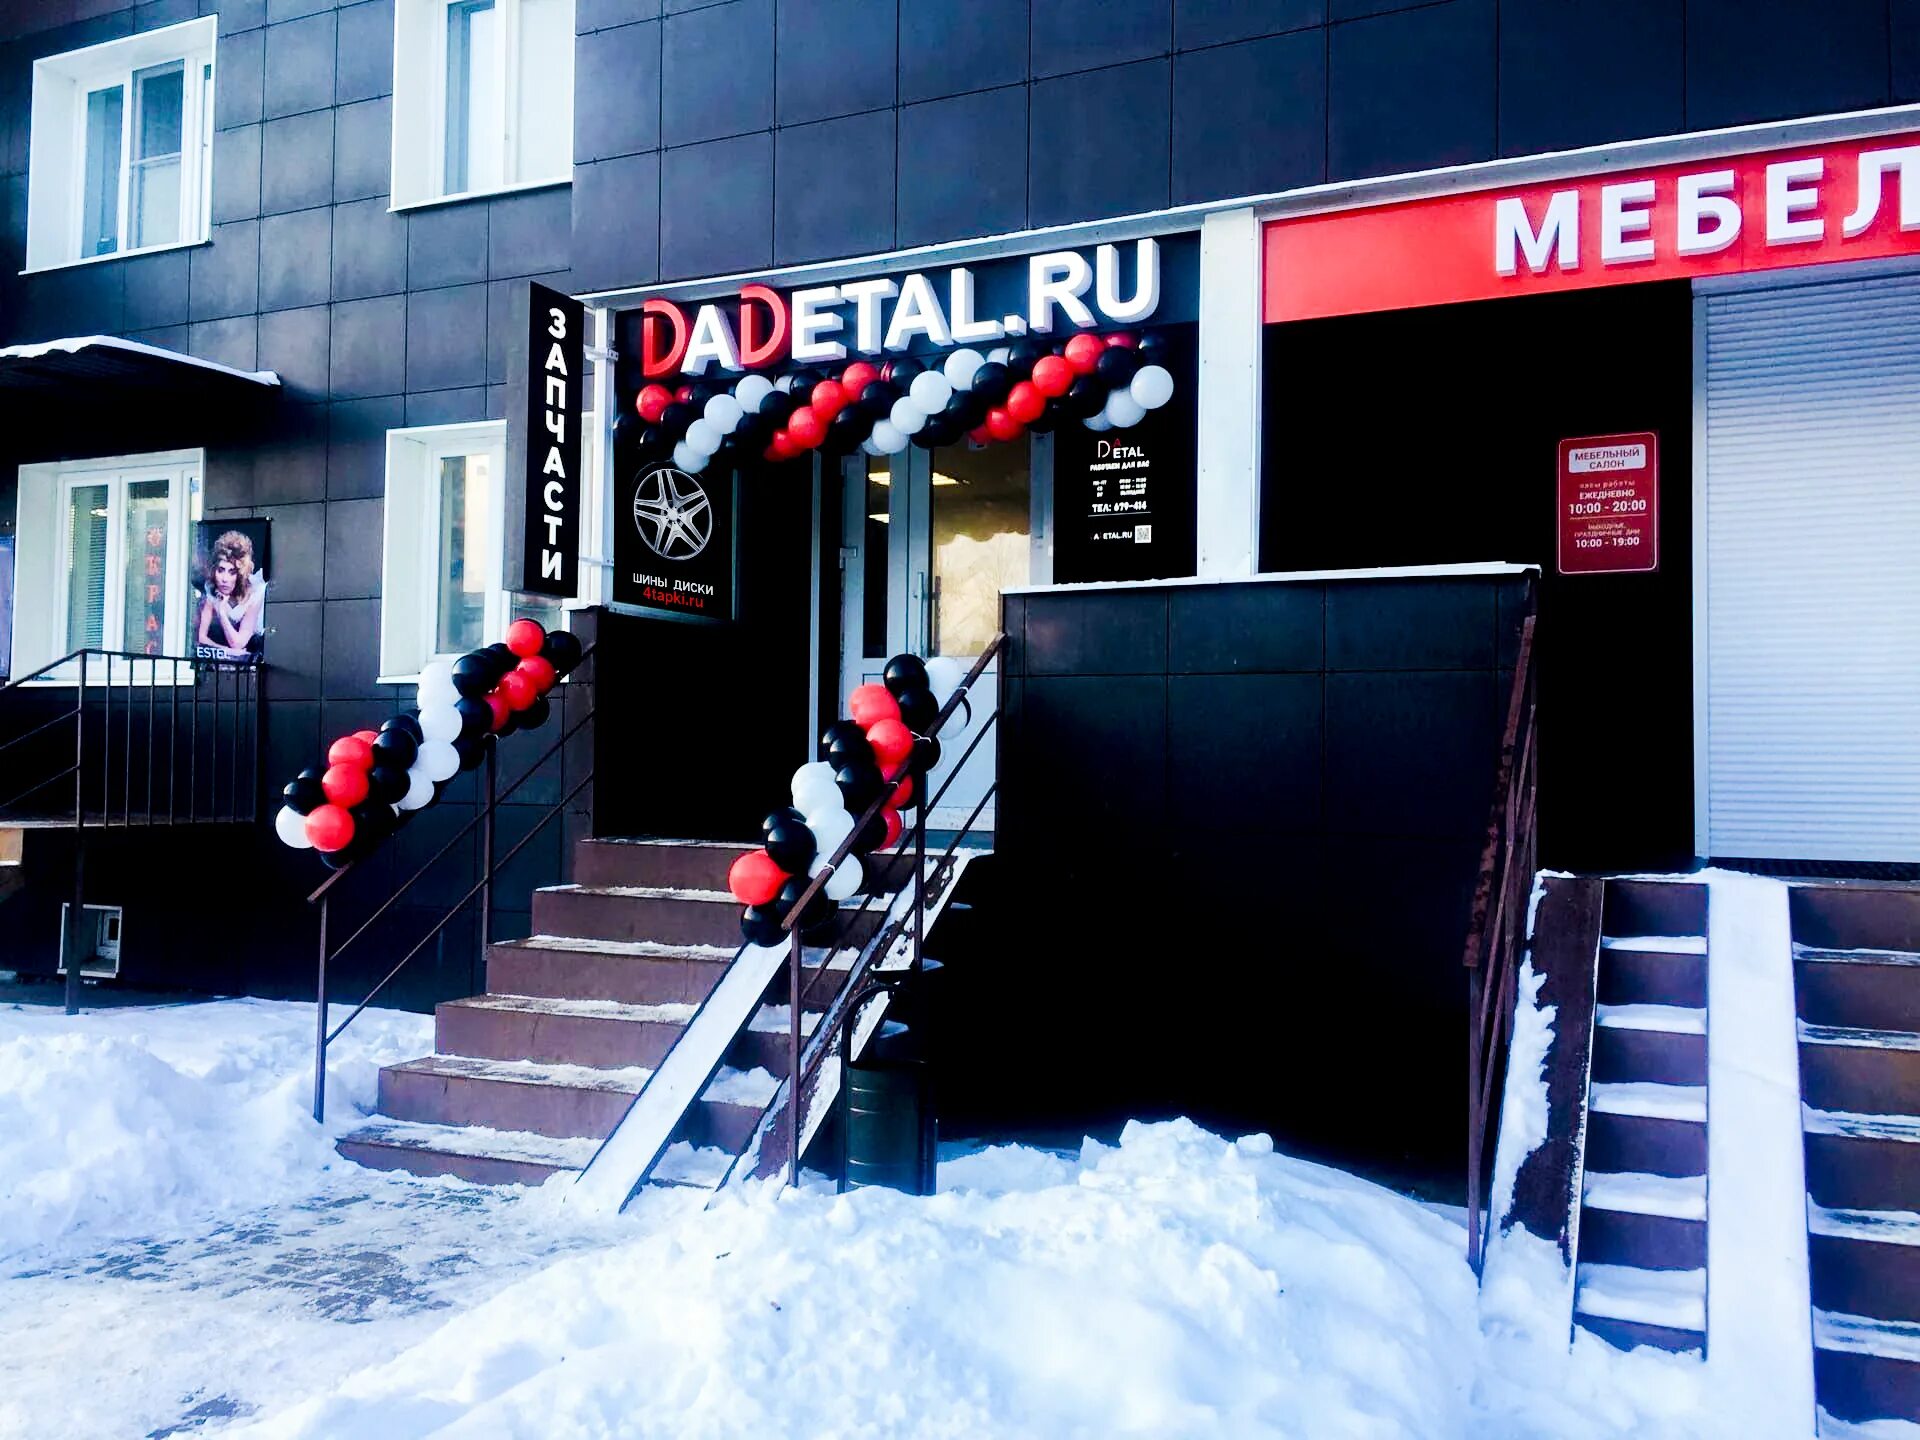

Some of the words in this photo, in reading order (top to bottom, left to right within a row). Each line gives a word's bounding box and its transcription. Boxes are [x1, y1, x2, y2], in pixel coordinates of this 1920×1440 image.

[1496, 145, 1920, 277] МЕБЕЛ
[642, 237, 1161, 378] DADETAL.RU
[541, 307, 568, 581] ЗАПЧАСТИ
[1575, 448, 1640, 461] МЕБЕЛЬНЫЙ
[1589, 460, 1625, 470] САЛОН
[1579, 489, 1635, 500] ЕЖЕДНЕВНО
[1092, 503, 1112, 513] ТЕЛ:
[1569, 502, 1601, 515] 10:00
[1612, 499, 1646, 512] 20:00
[1576, 538, 1603, 549] 10:00
[1612, 536, 1640, 547] 19:00
[633, 572, 668, 588] ШИНЫ
[673, 579, 714, 595] ДИСКИ
[643, 586, 704, 608] 4tapki.ru
